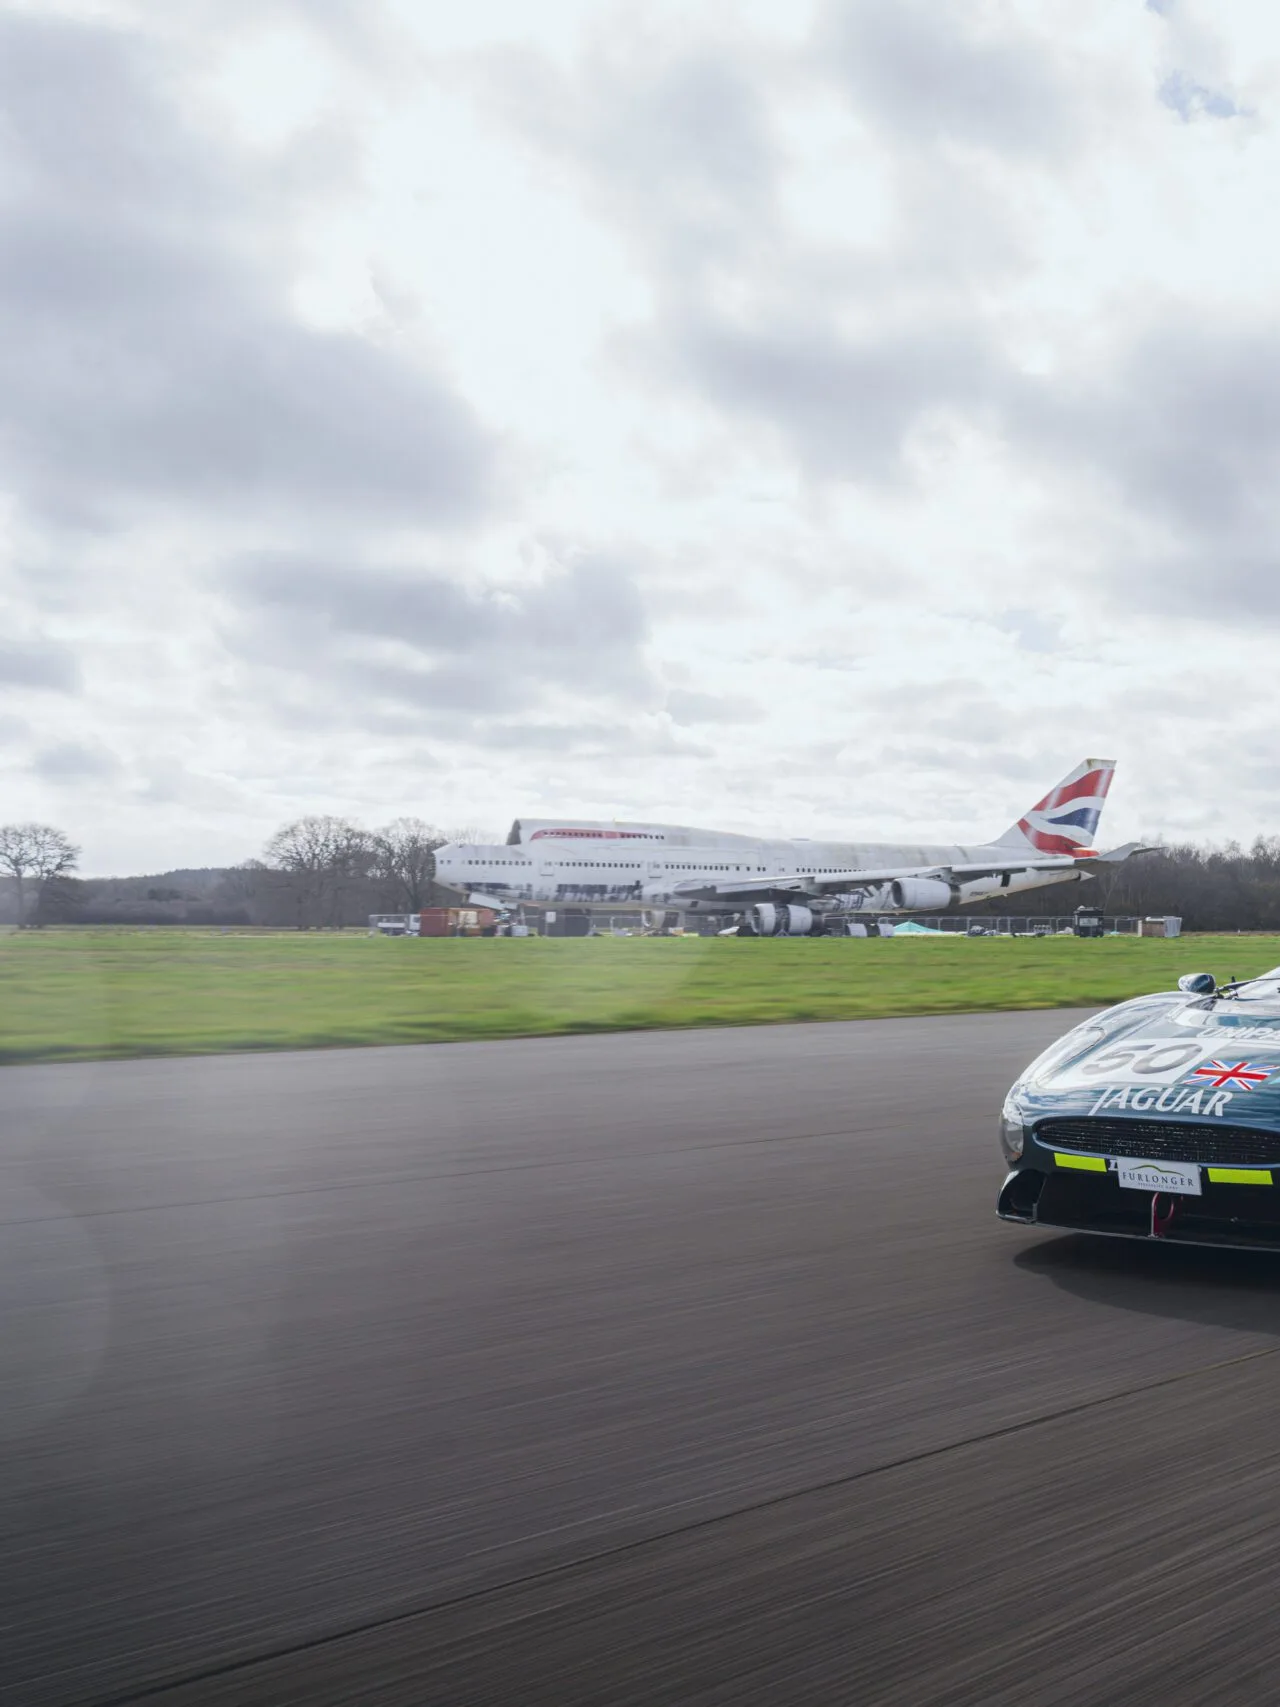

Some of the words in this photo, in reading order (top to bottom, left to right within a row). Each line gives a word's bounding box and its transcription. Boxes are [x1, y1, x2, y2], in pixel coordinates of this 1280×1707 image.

[1082, 1043, 1203, 1075] 50
[1088, 1086, 1232, 1117] JAGUAR
[1122, 1171, 1194, 1187] FURLONGER
